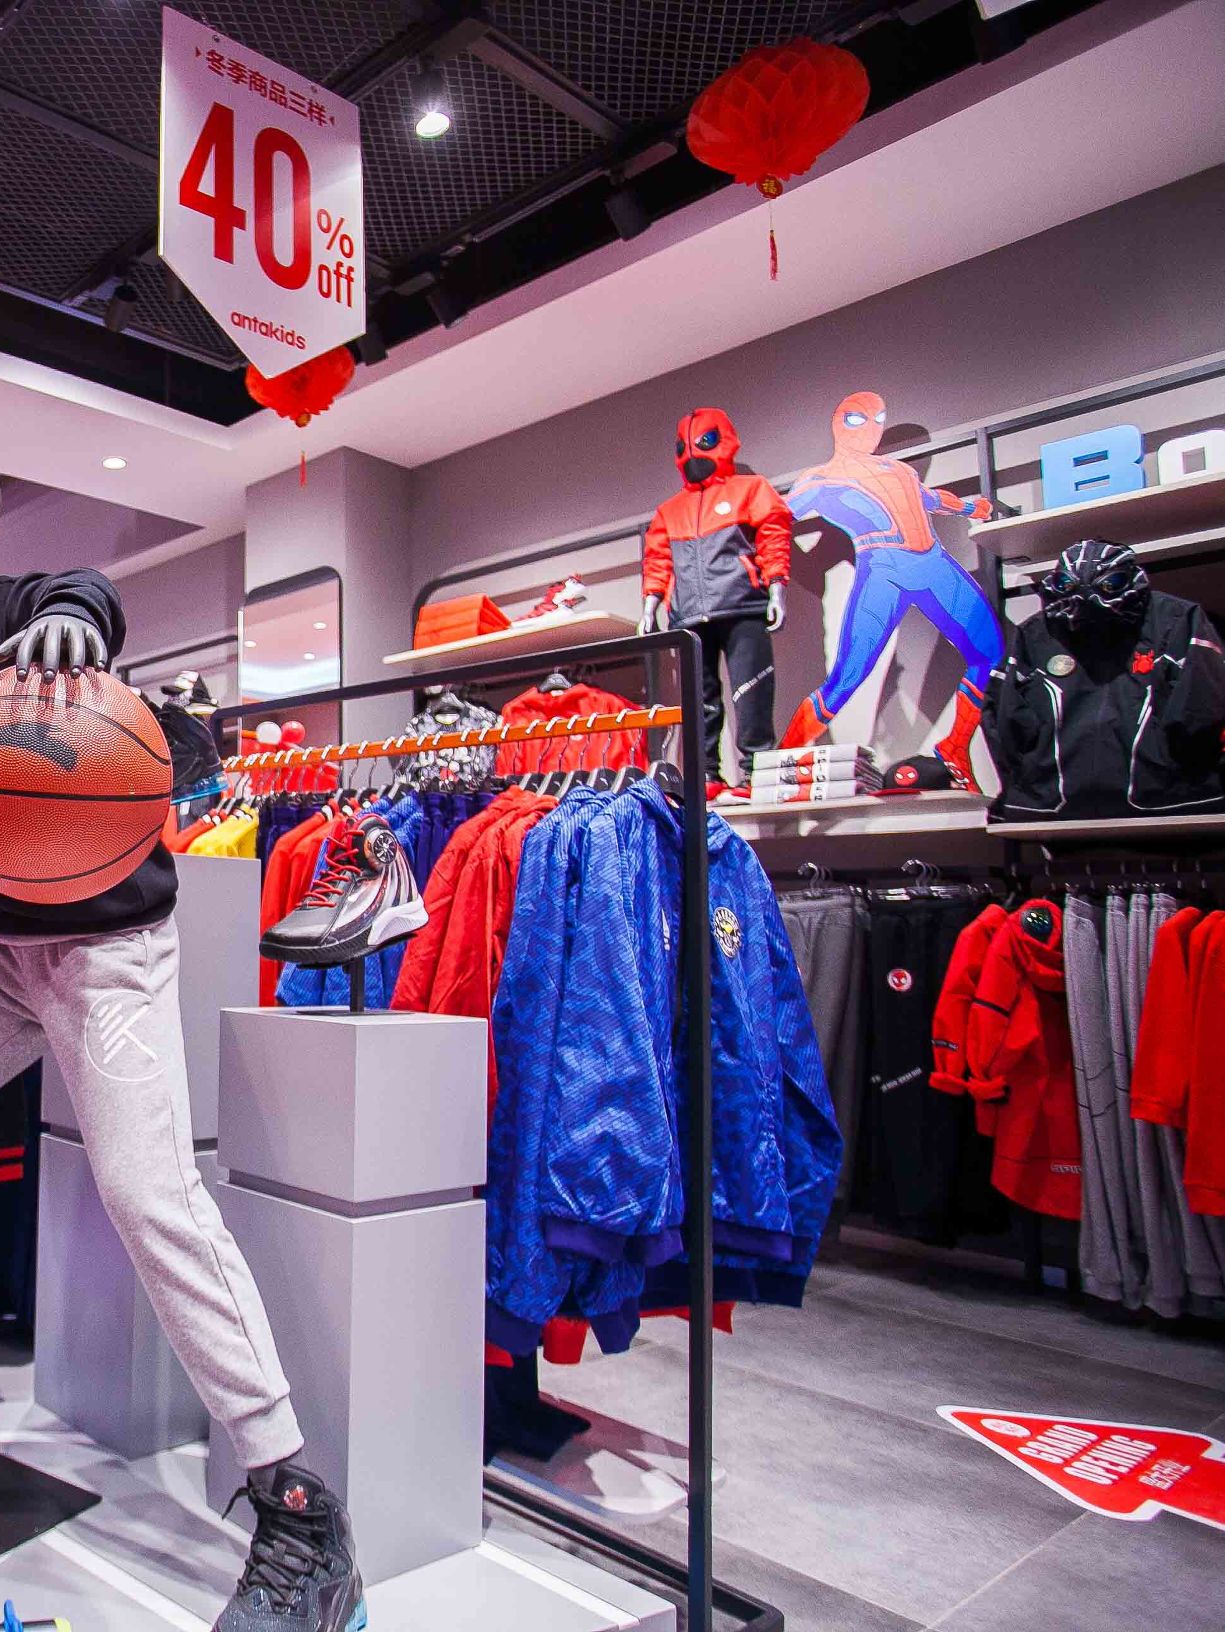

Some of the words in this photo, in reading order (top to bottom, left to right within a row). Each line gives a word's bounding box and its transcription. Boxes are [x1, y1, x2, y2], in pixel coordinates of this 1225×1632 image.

[205, 48, 328, 128] 冬季商品三样
[179, 101, 312, 291] 40
[317, 260, 355, 308] off
[230, 310, 307, 350] antakids
[1017, 1424, 1098, 1464] GRAND
[1063, 1435, 1158, 1485] OPENING
